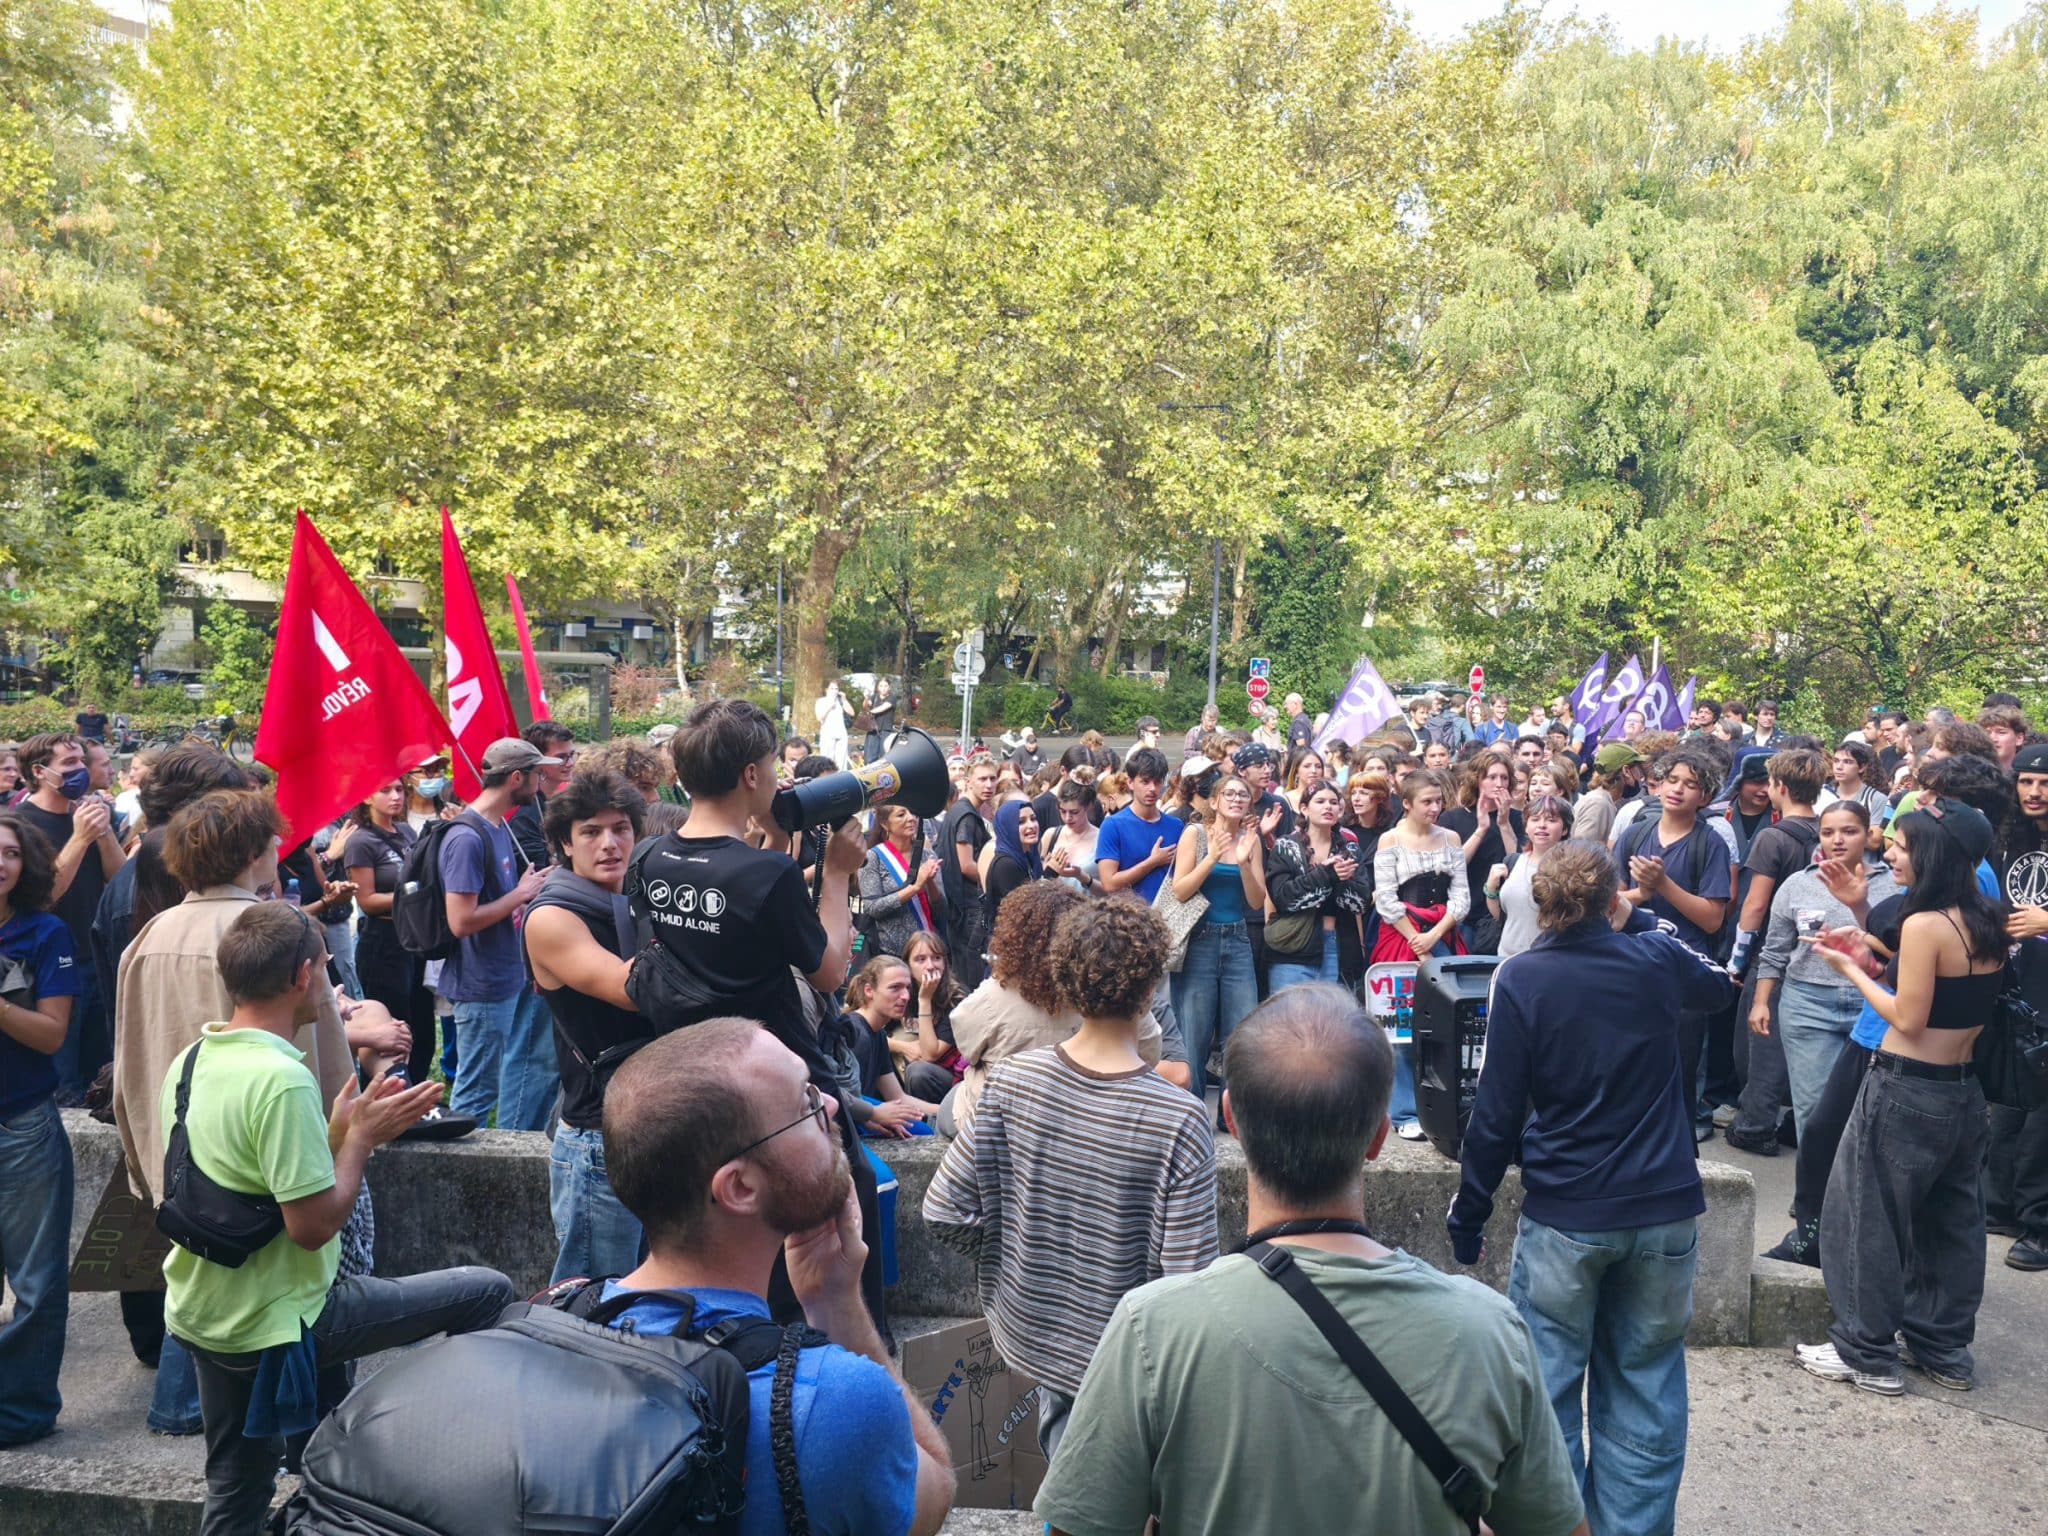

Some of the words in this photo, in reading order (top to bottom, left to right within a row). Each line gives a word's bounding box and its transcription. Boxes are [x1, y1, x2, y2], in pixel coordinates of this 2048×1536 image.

[1249, 684, 1267, 692] STOP
[660, 912, 683, 927] MUD
[685, 917, 721, 935] ALONE
